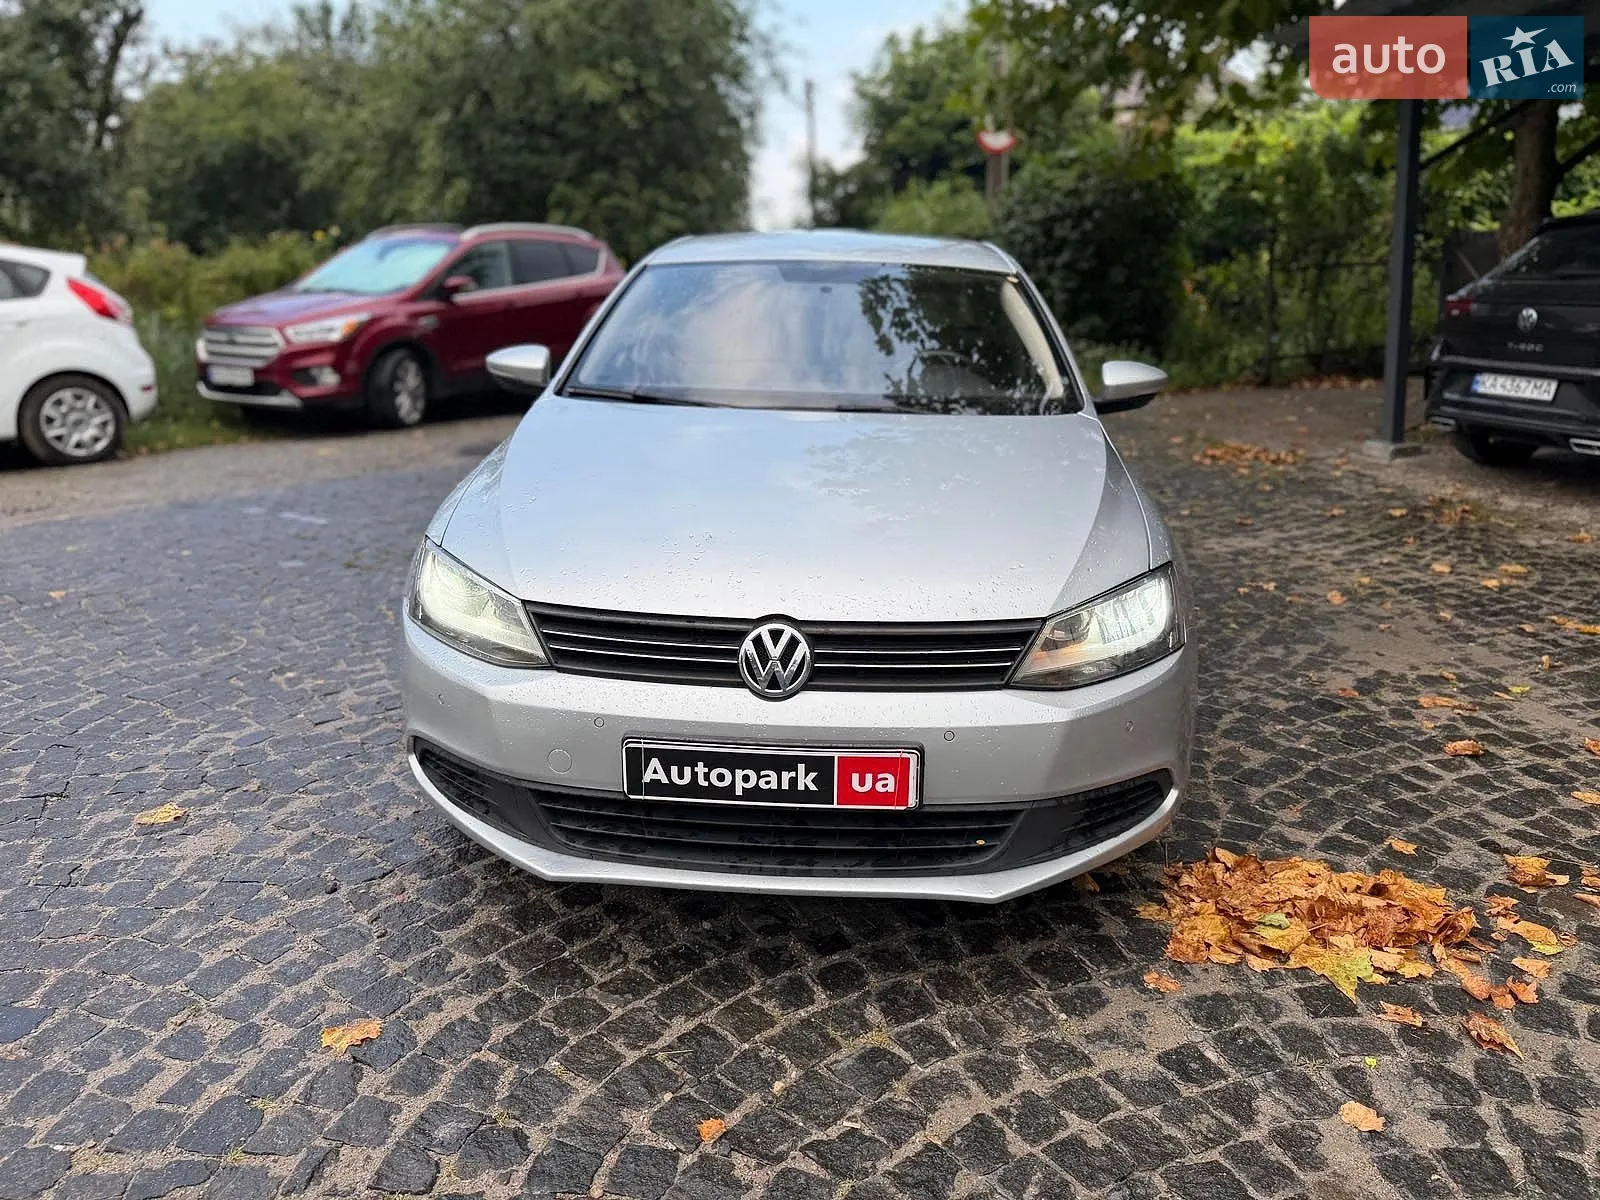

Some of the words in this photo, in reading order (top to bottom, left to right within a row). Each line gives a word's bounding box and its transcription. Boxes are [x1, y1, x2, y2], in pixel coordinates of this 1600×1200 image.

[740, 624, 811, 693] VW
[642, 757, 819, 796] Autopark
[850, 772, 896, 793] ua
